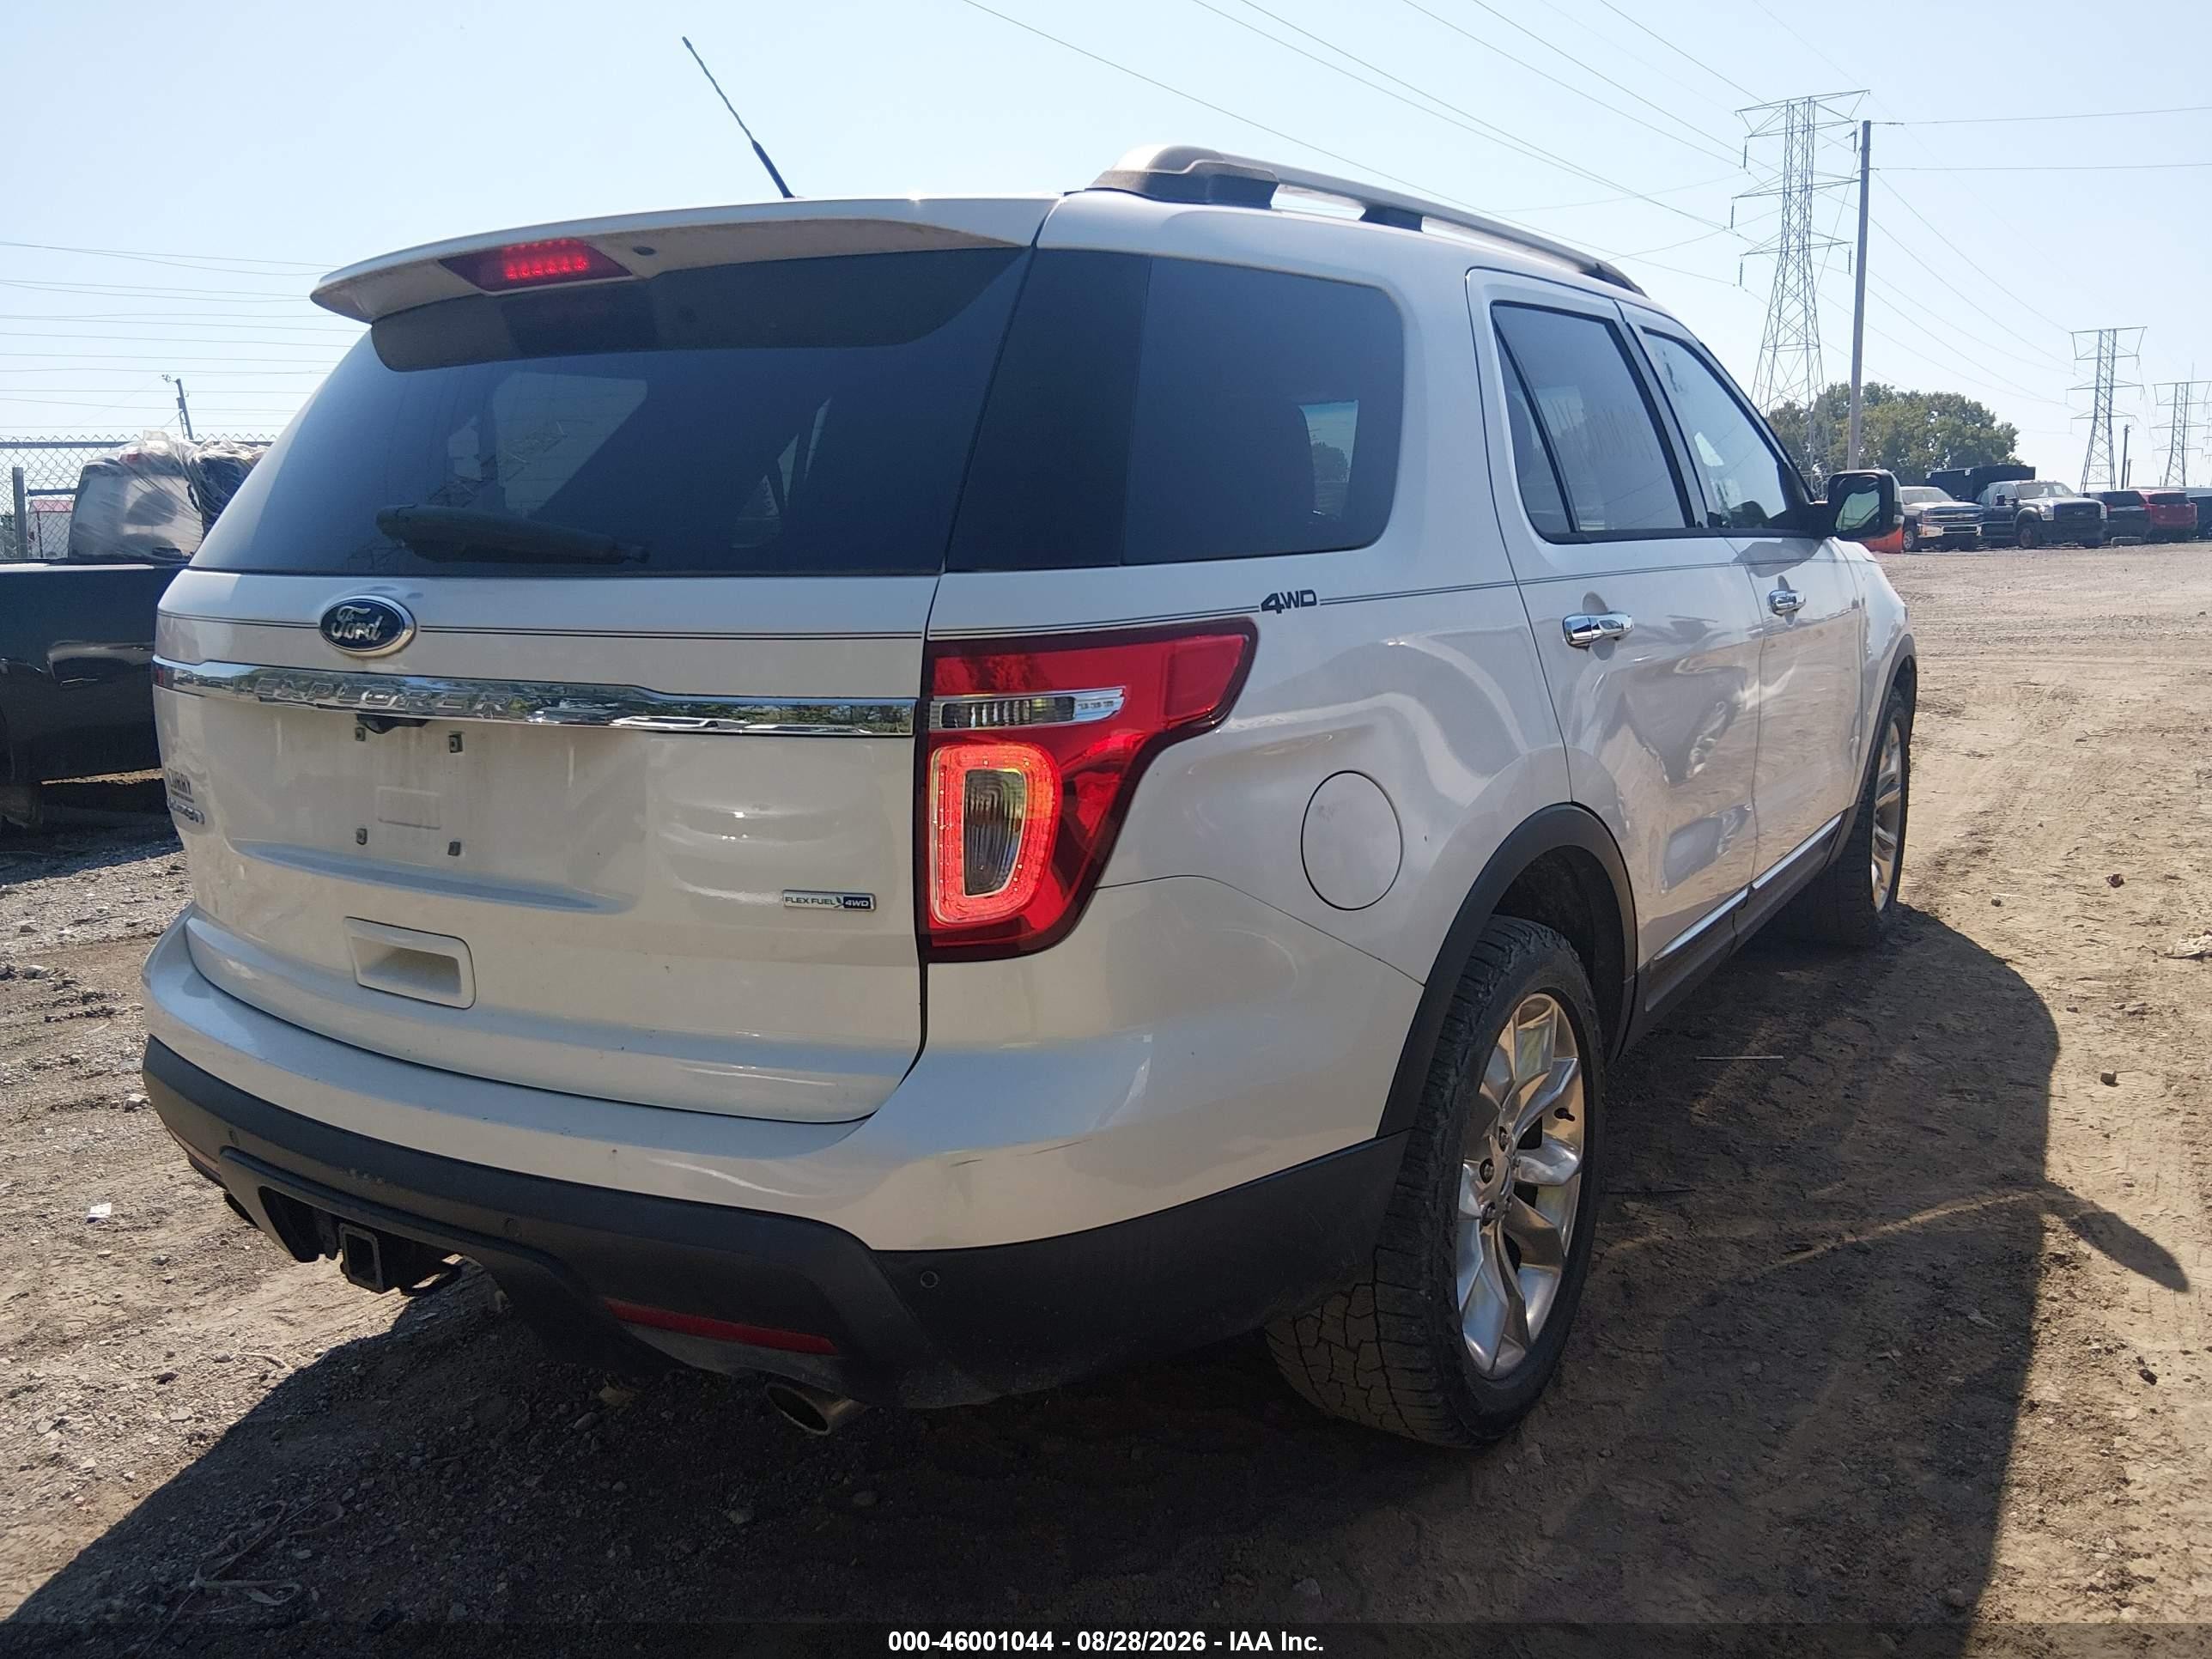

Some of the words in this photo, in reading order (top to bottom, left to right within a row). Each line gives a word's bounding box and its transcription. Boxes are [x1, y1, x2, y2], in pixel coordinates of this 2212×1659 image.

[1261, 590, 1317, 614] 4WD
[331, 605, 384, 641] Ford
[254, 678, 514, 720] EXPLORER
